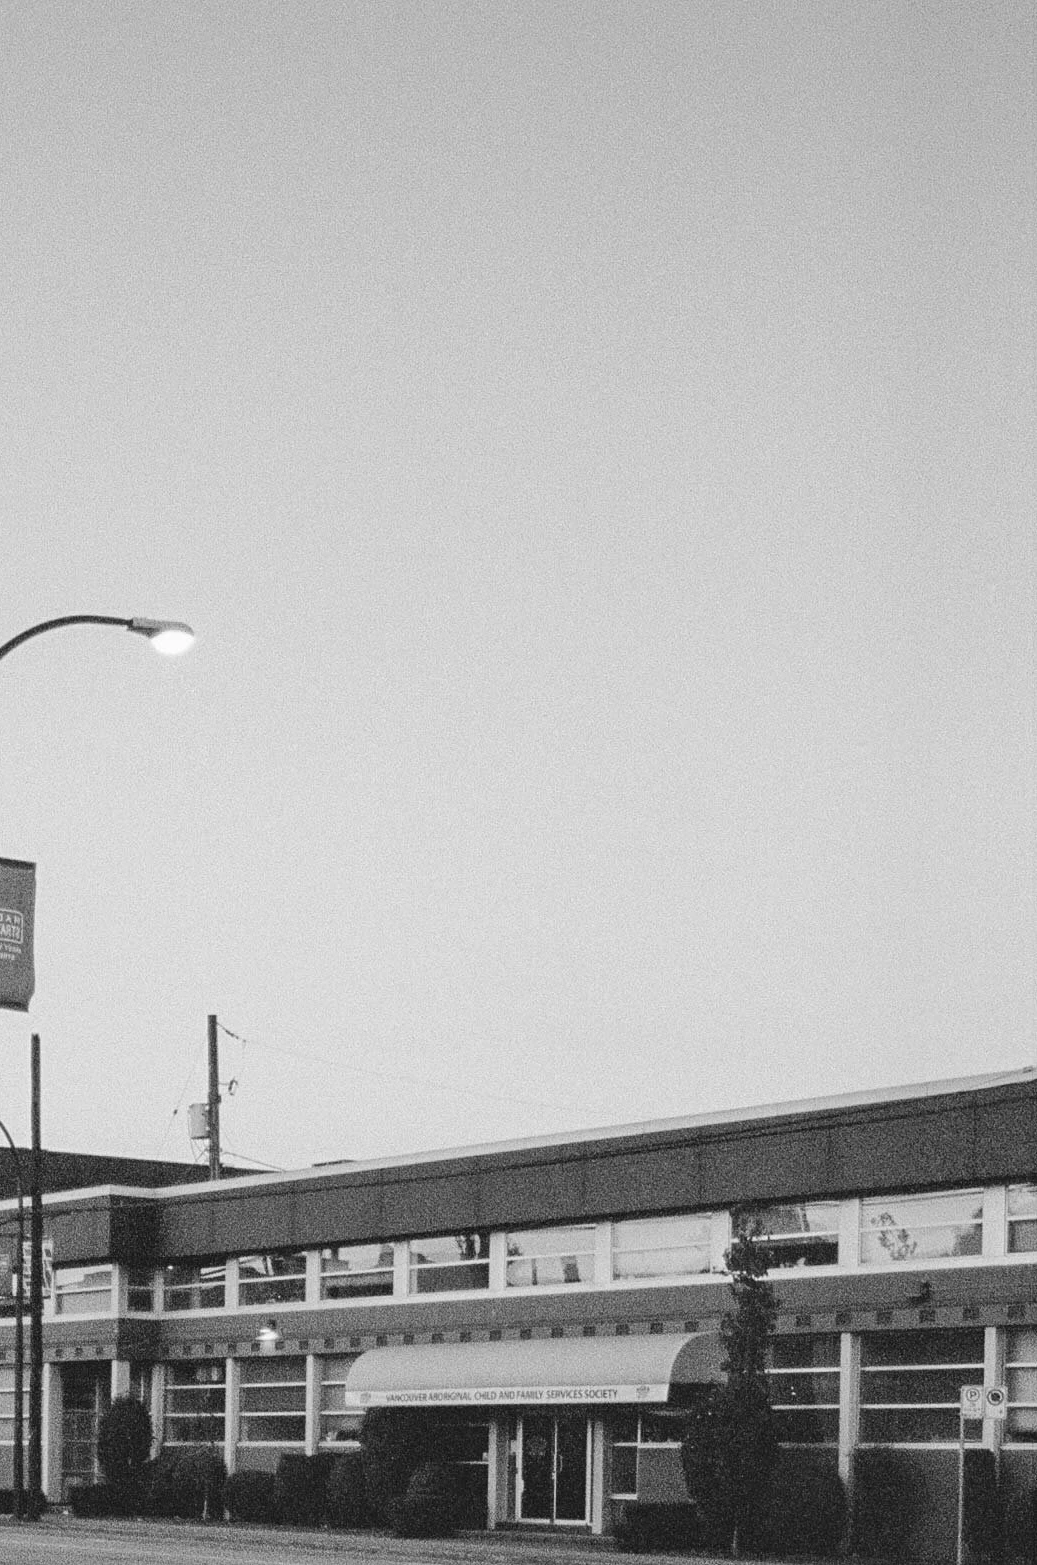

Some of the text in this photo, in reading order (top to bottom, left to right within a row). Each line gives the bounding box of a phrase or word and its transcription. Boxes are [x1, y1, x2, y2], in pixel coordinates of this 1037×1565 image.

[386, 1389, 618, 1402] VANCOUVER ABORIGINAL CHILD AND FAMILY SERVICES SOCIETY
